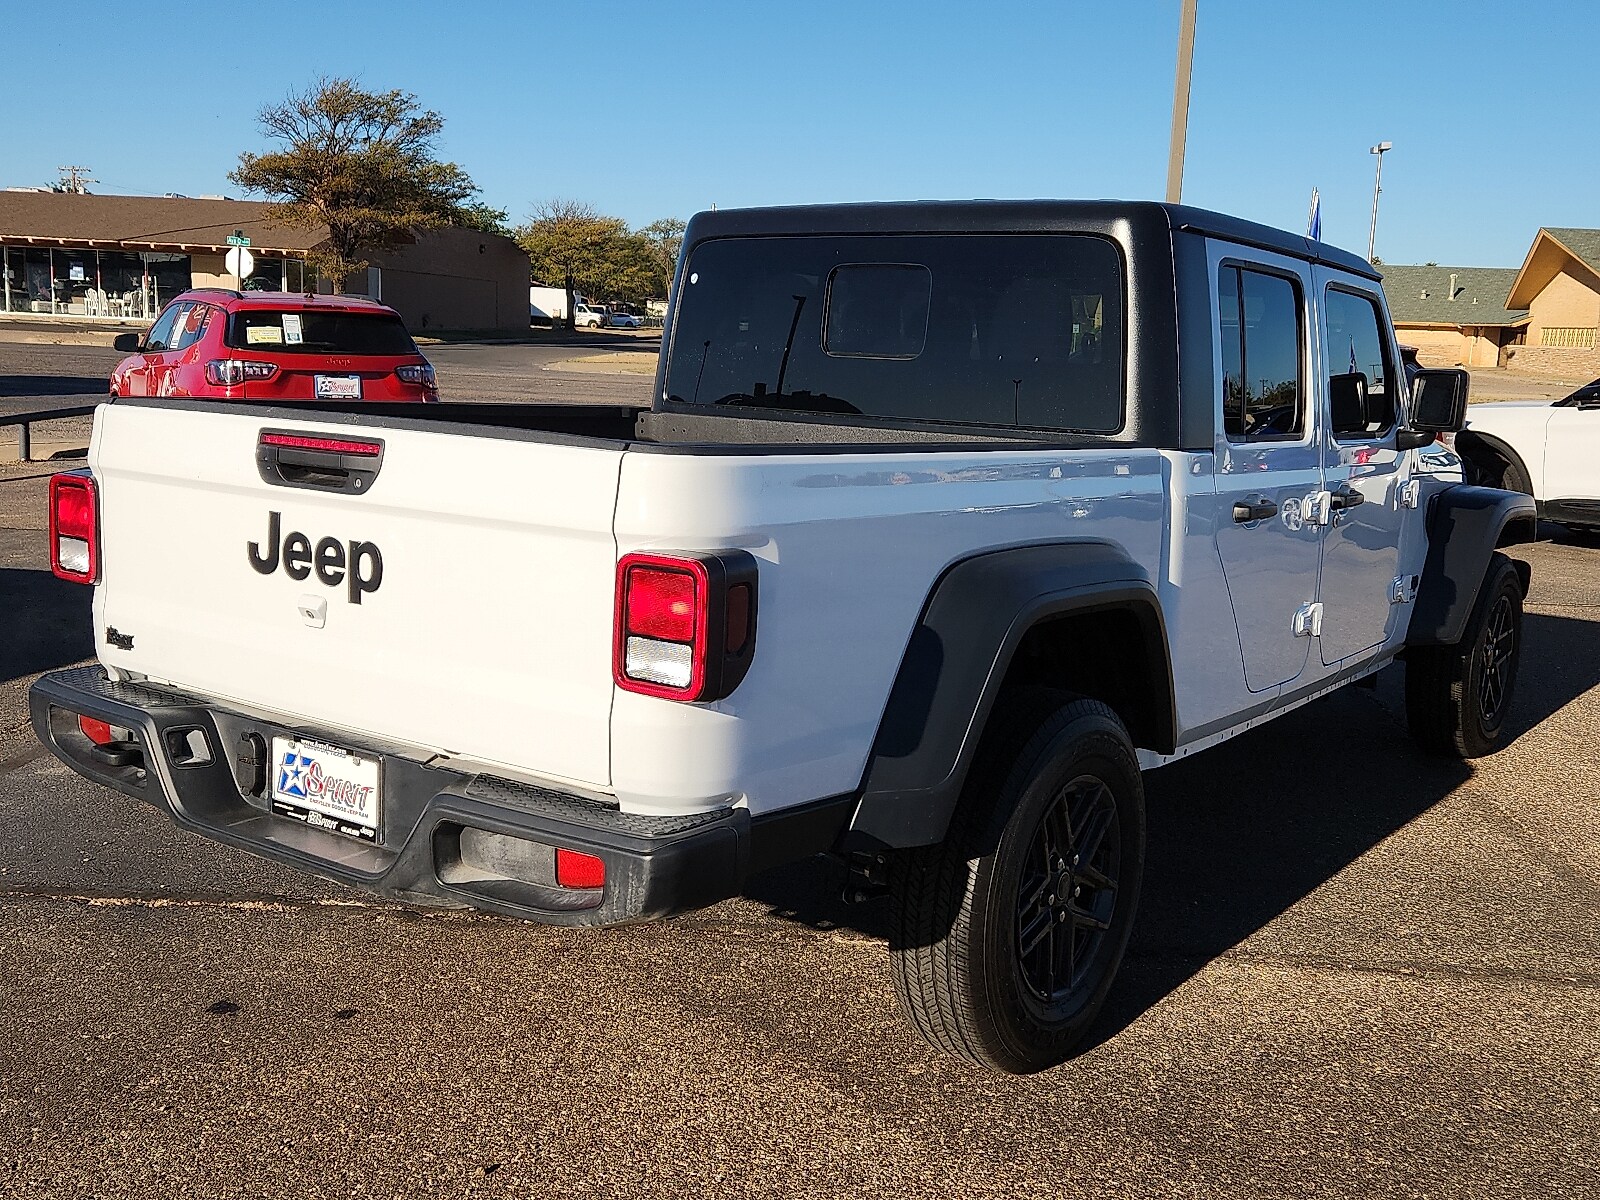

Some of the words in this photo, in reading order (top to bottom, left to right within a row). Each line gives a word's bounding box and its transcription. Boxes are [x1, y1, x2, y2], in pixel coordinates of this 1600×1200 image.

[247, 511, 383, 605] Jeep
[305, 762, 374, 811] SPIRIT
[331, 803, 347, 813] DODGE
[347, 809, 358, 817] JEEP
